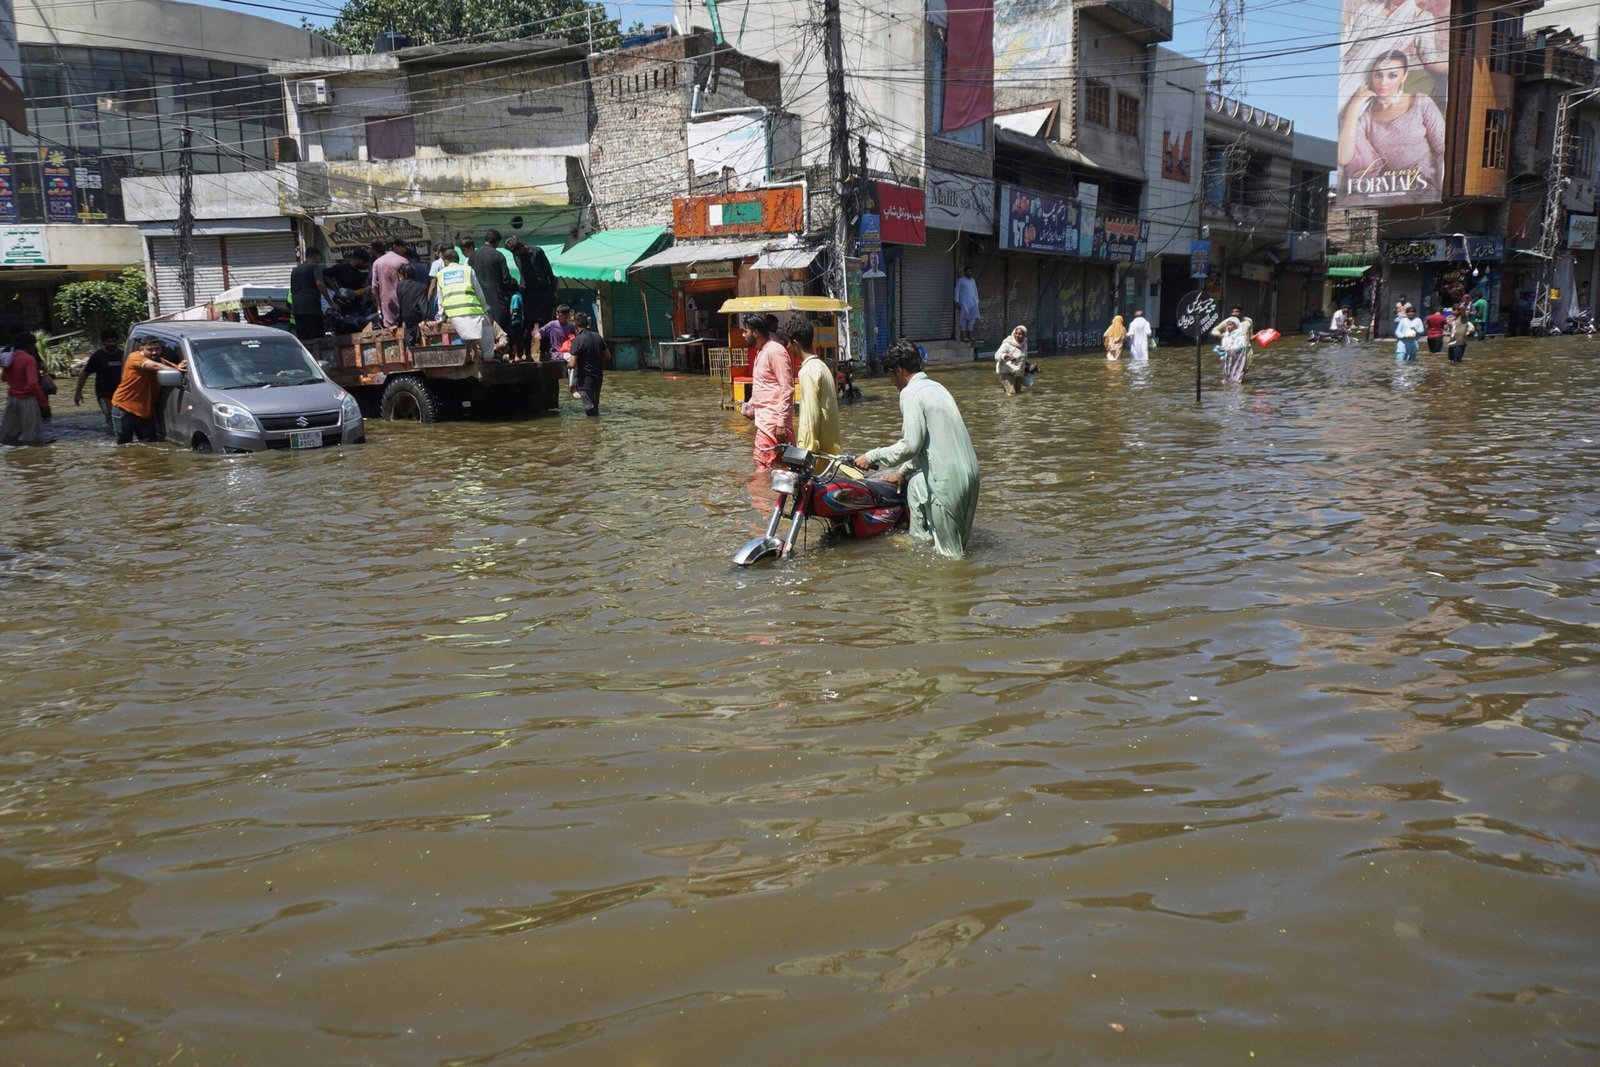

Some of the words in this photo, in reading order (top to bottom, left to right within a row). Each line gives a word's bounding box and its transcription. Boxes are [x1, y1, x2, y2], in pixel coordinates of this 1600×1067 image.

[1353, 157, 1423, 187] Luxury
[1347, 174, 1428, 195] FORMALS
[931, 186, 958, 207] Malik
[333, 232, 359, 243] RAJA
[359, 230, 388, 239] HAIR
[389, 228, 422, 238] FASHION
